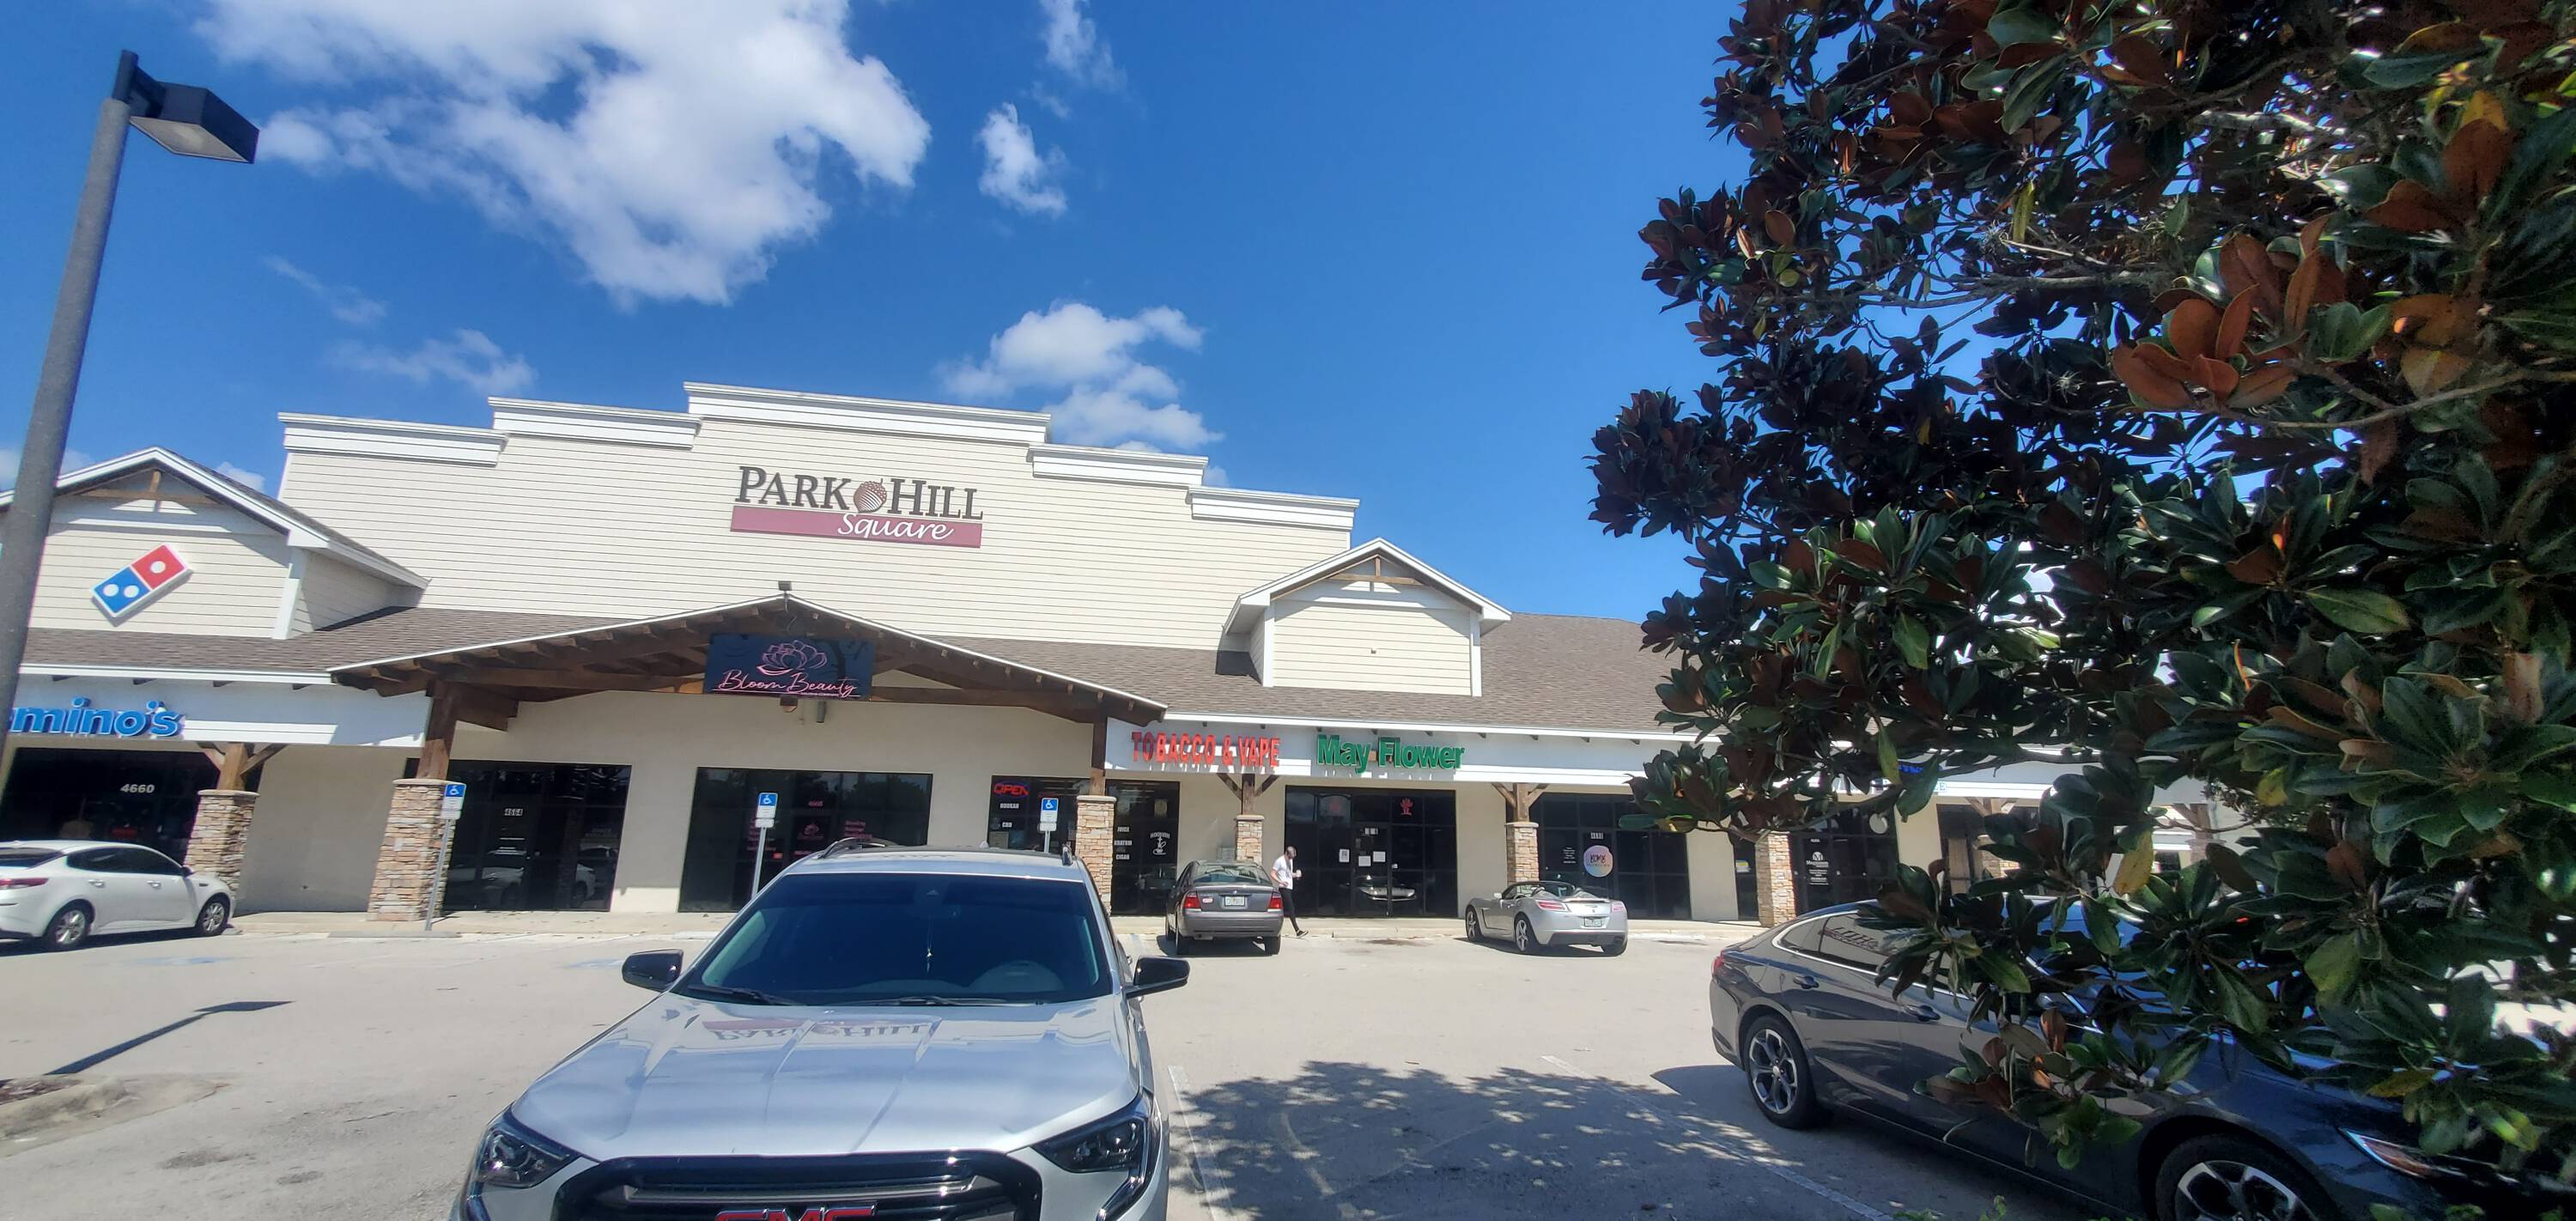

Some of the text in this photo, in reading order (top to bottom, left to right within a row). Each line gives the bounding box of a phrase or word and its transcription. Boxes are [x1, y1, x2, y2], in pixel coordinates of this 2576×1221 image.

[735, 466, 983, 519] PARK HILL
[837, 513, 954, 540] Square
[718, 669, 858, 697] Bloom Beauty
[8, 696, 183, 738] mino's
[1131, 732, 1280, 768] TOBACCO & VAPE
[1316, 734, 1466, 775] May Flower
[120, 784, 155, 793] 4660
[993, 783, 1030, 797] OPEN
